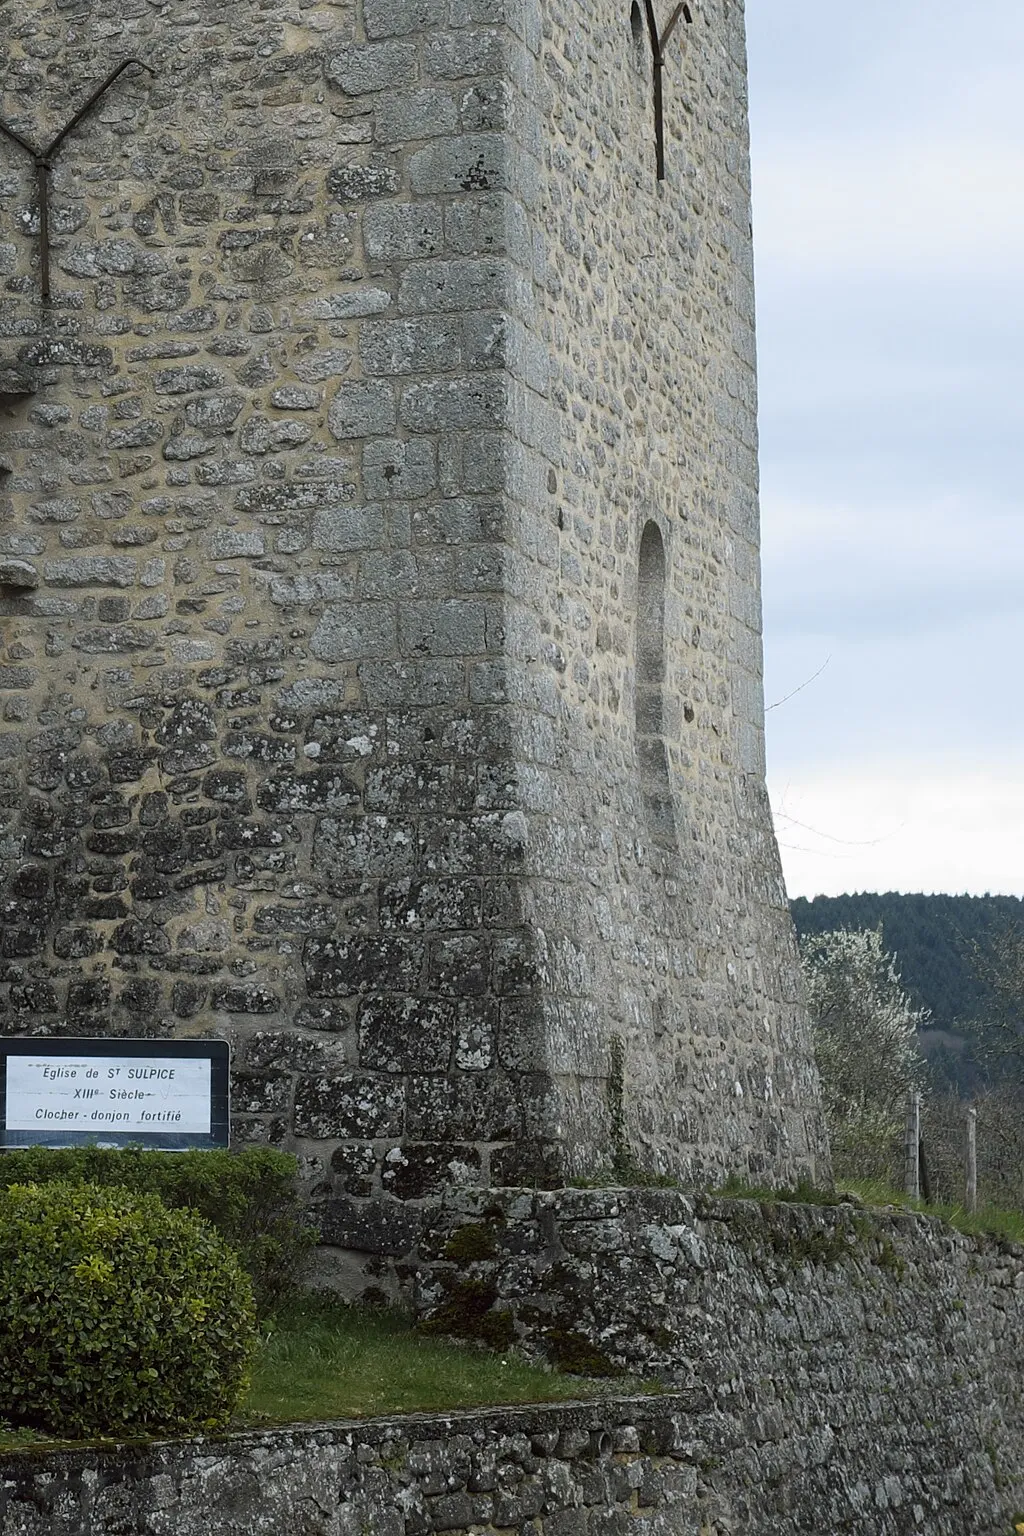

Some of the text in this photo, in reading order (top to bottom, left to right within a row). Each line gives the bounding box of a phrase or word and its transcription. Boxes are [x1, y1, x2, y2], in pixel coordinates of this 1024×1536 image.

[85, 1068, 99, 1079] de
[127, 1069, 175, 1079] SULPICE
[109, 1089, 144, 1100] Siècle
[35, 1109, 79, 1120] Clocher
[91, 1110, 130, 1123] donjon
[140, 1110, 181, 1121] fortifié
